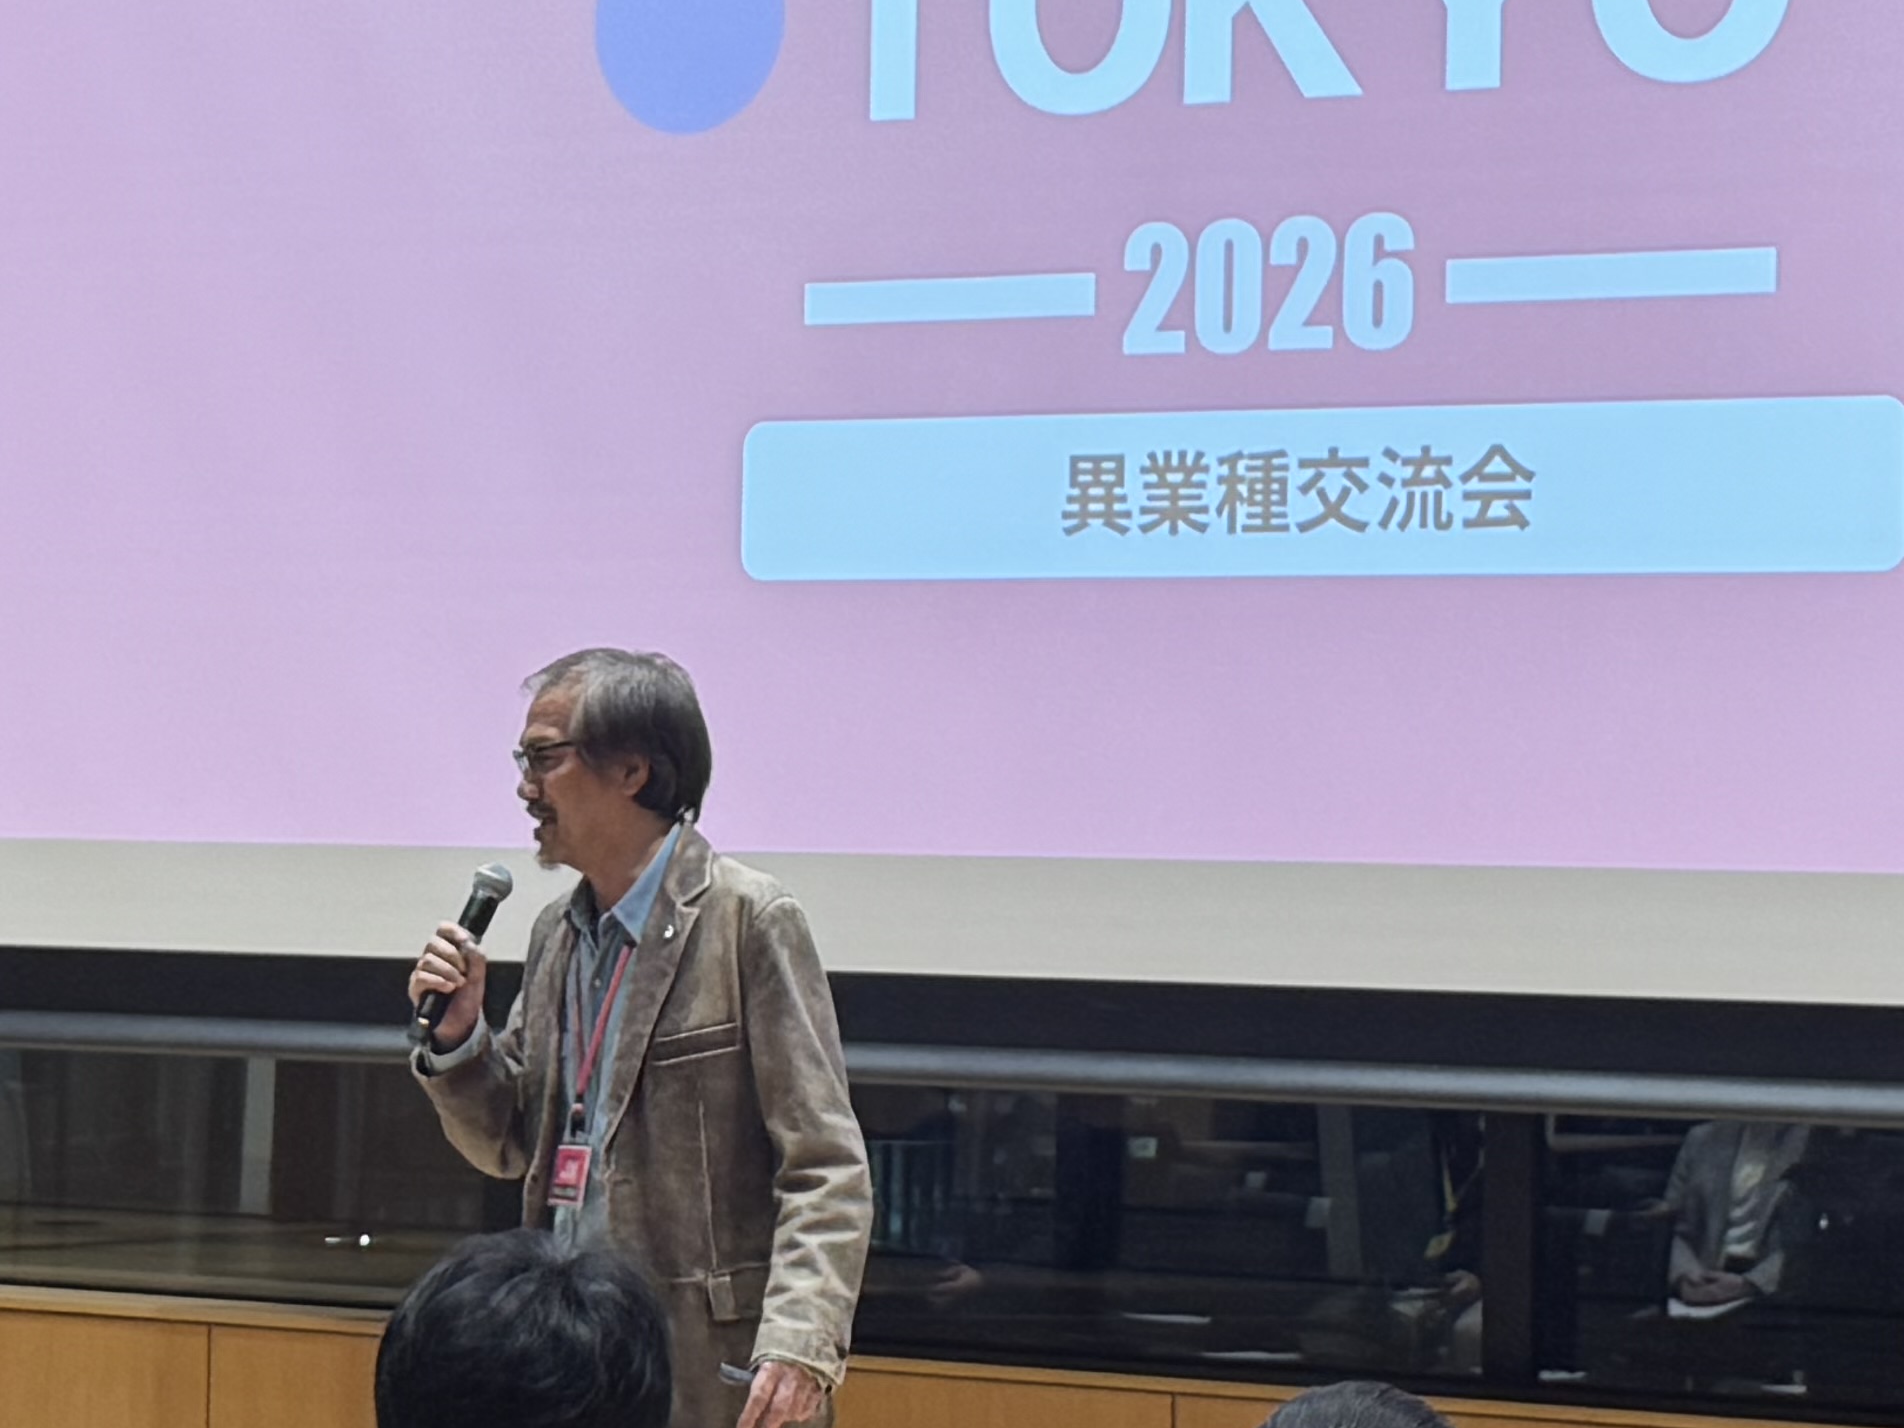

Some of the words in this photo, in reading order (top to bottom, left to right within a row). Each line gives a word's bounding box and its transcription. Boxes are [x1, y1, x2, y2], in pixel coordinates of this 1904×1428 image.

[1121, 211, 1416, 356] 2026
[1060, 443, 1536, 537] 異業種交流会
